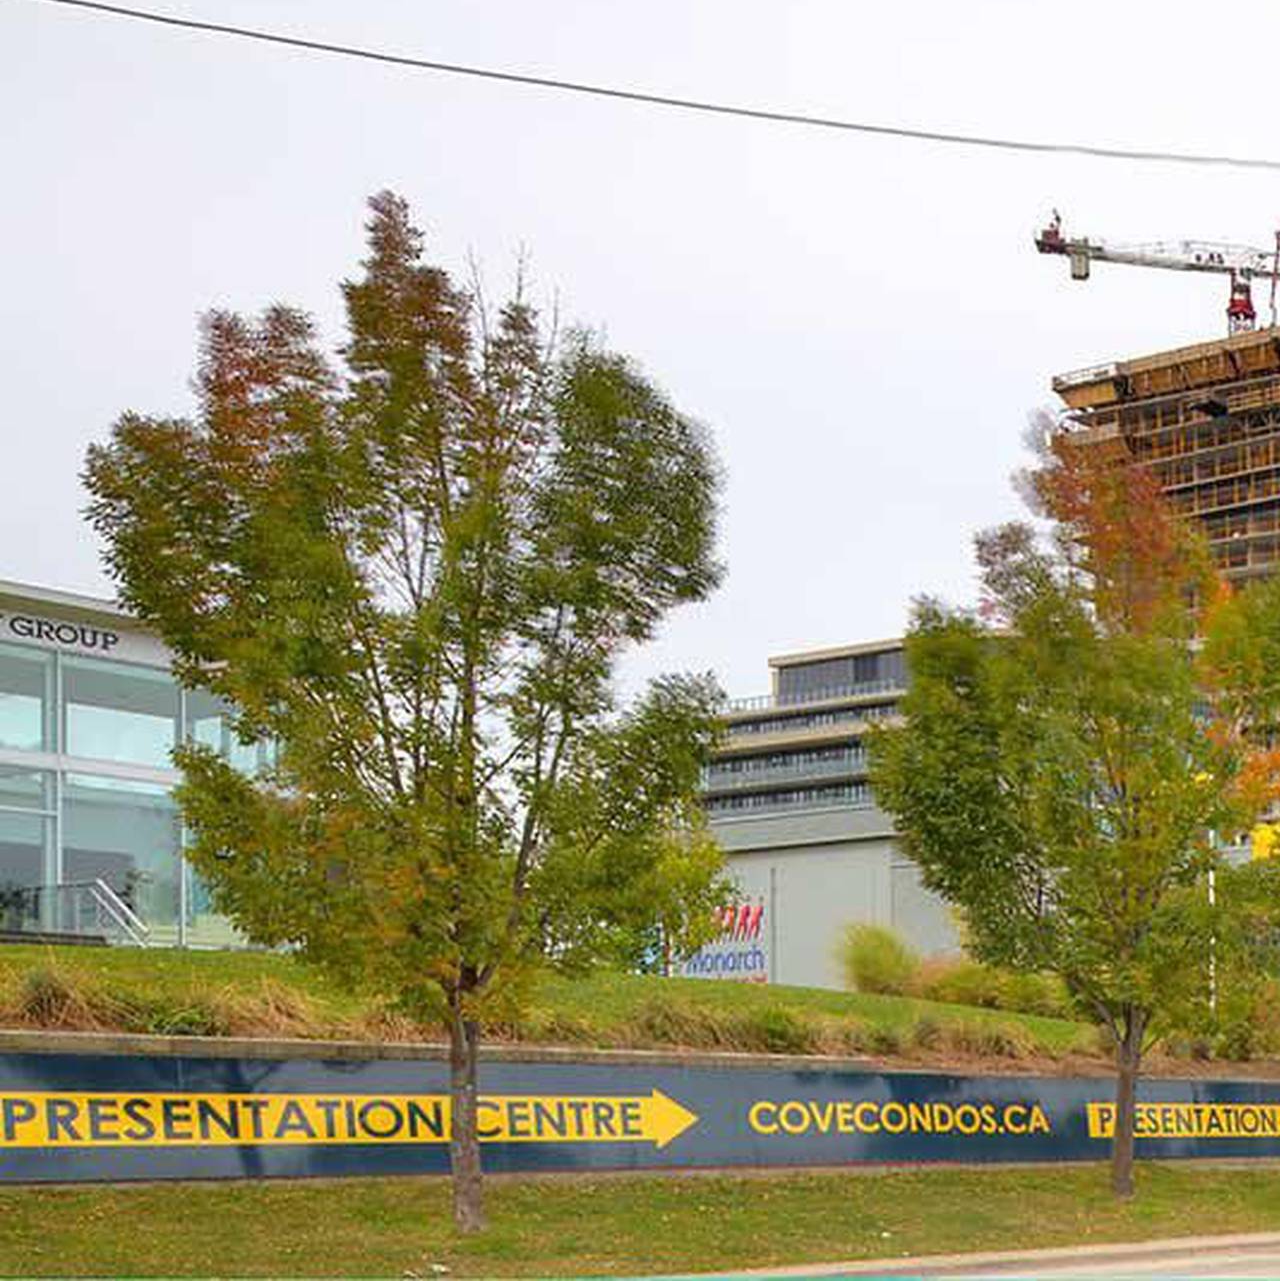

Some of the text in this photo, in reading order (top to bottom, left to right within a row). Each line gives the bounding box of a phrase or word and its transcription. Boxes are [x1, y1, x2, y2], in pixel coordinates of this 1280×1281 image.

[9, 616, 119, 650] GROUP
[2, 1098, 643, 1140] PRESENTATION CENTRE
[749, 1101, 1051, 1134] COVECONDOS.CA
[1099, 1107, 1277, 1134] PESENTATION
